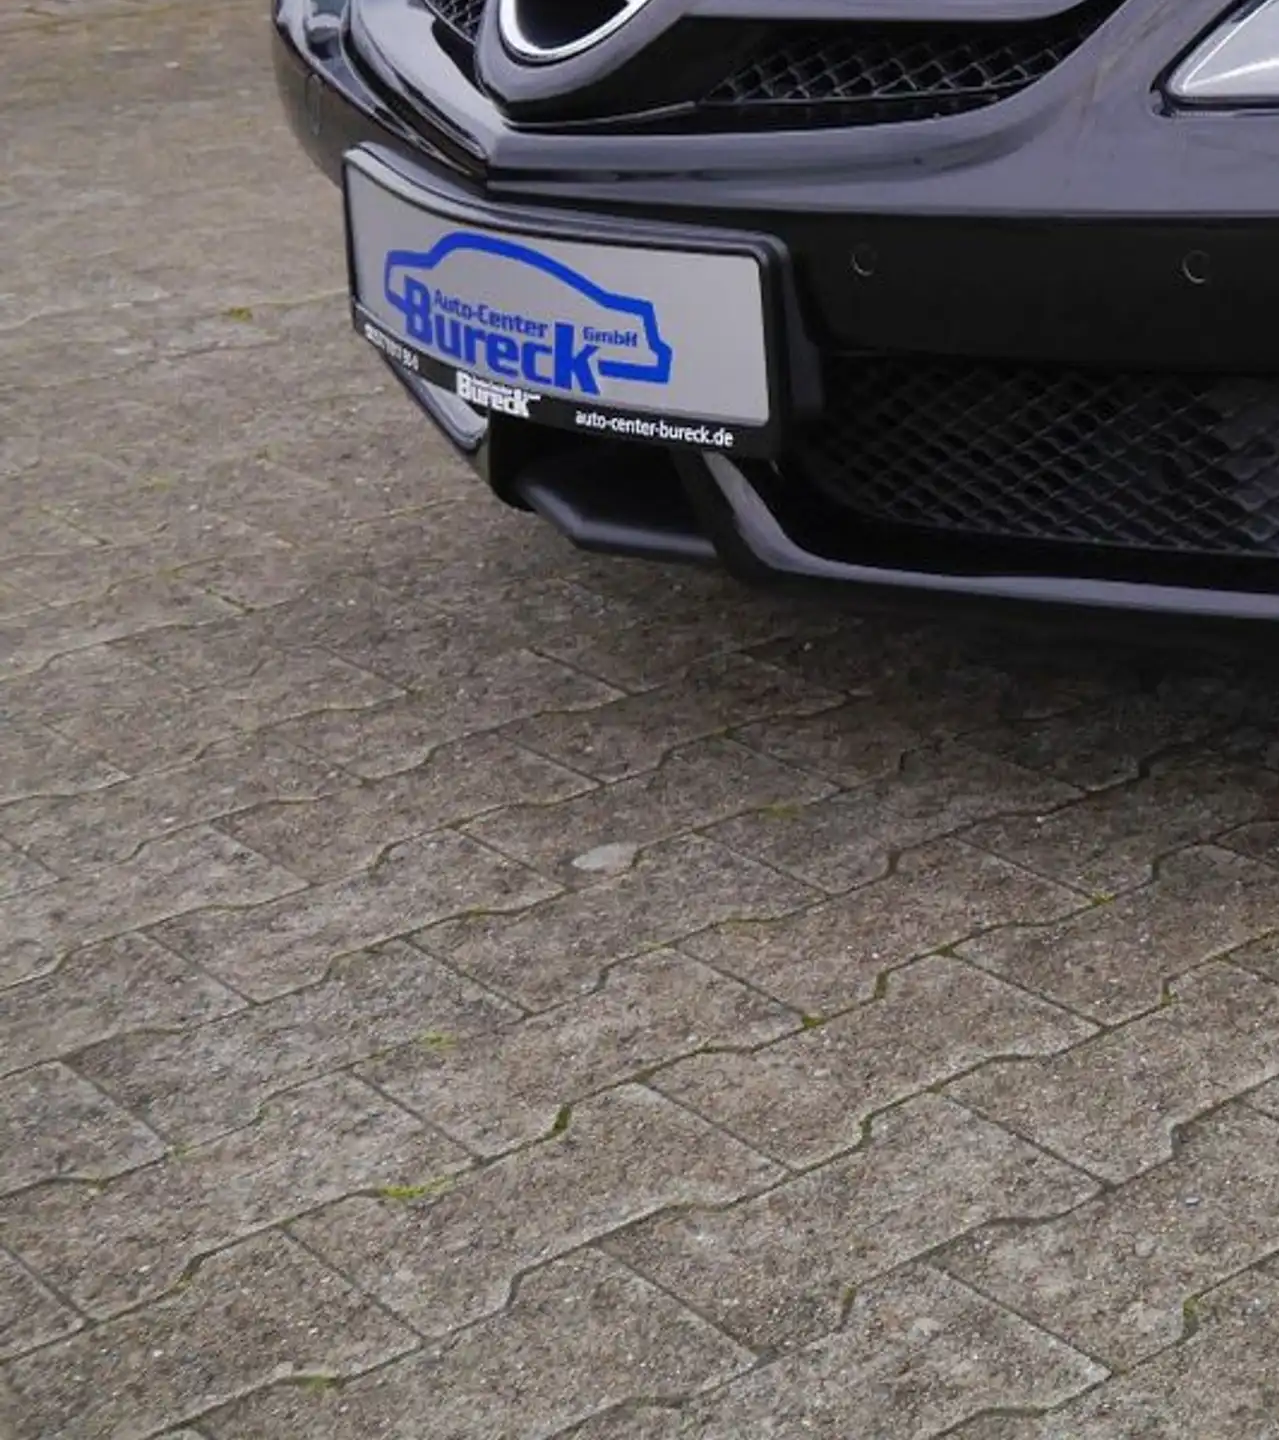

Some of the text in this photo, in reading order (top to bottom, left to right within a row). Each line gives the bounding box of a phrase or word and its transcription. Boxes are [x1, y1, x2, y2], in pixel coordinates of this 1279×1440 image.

[404, 274, 601, 395] Bureck
[433, 289, 638, 348] Auto-Center GmbH
[456, 370, 530, 418] Bureck
[575, 410, 735, 448] auto-center-bureck.de
